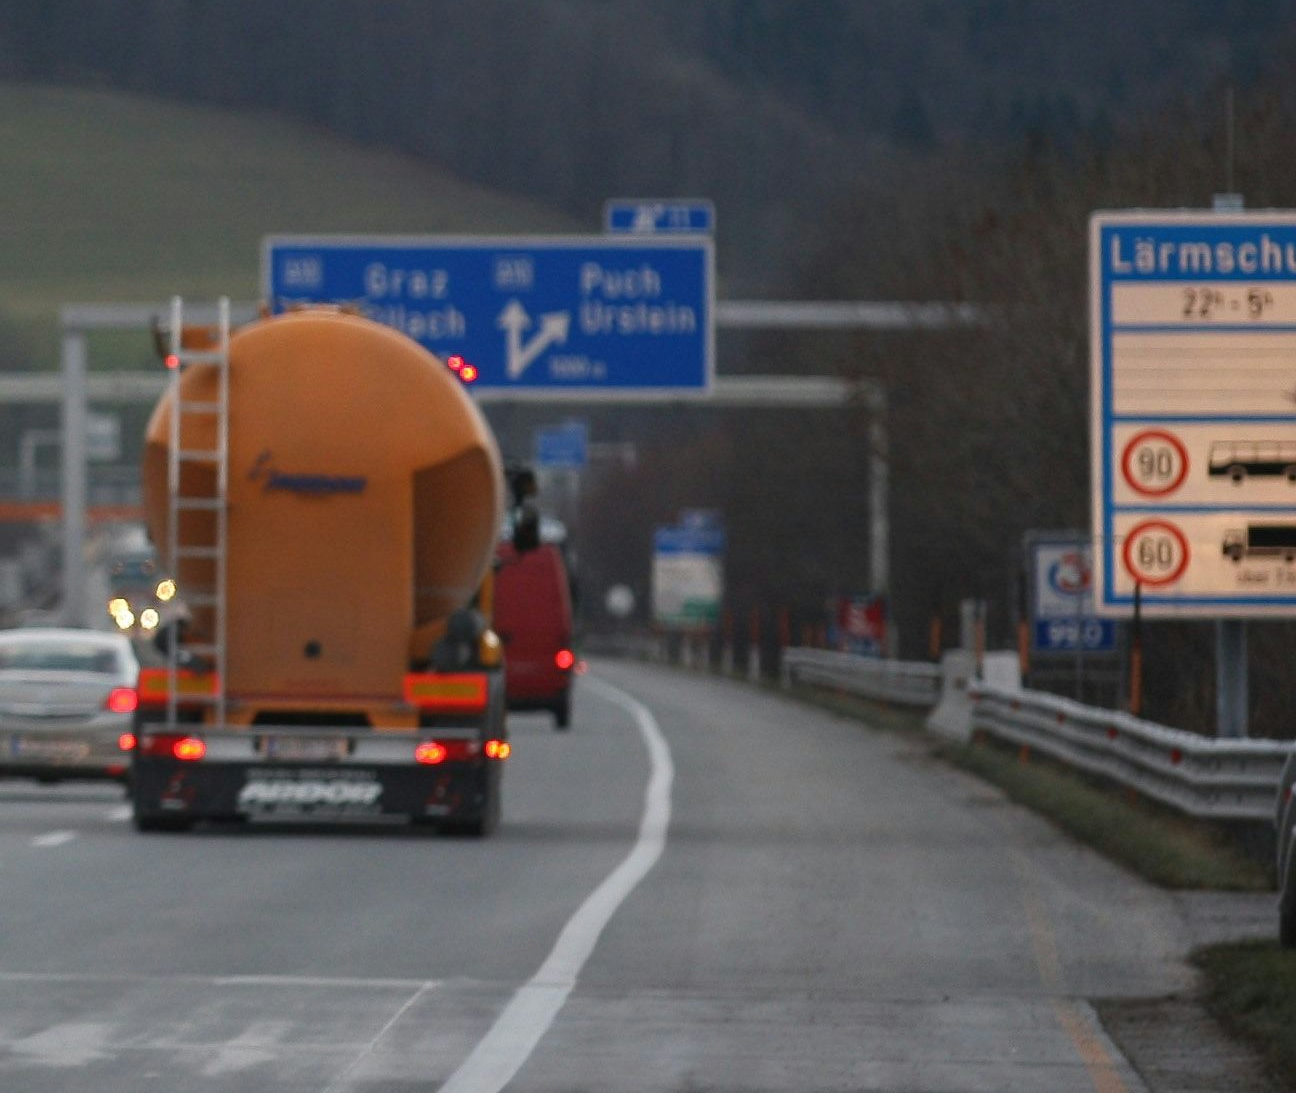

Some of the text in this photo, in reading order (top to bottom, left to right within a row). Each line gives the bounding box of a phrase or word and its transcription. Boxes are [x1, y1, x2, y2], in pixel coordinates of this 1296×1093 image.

[365, 262, 449, 298] Graz
[580, 261, 662, 299] Puch
[579, 299, 696, 335] Urstein
[1138, 445, 1173, 480] 90
[1138, 535, 1173, 570] 60
